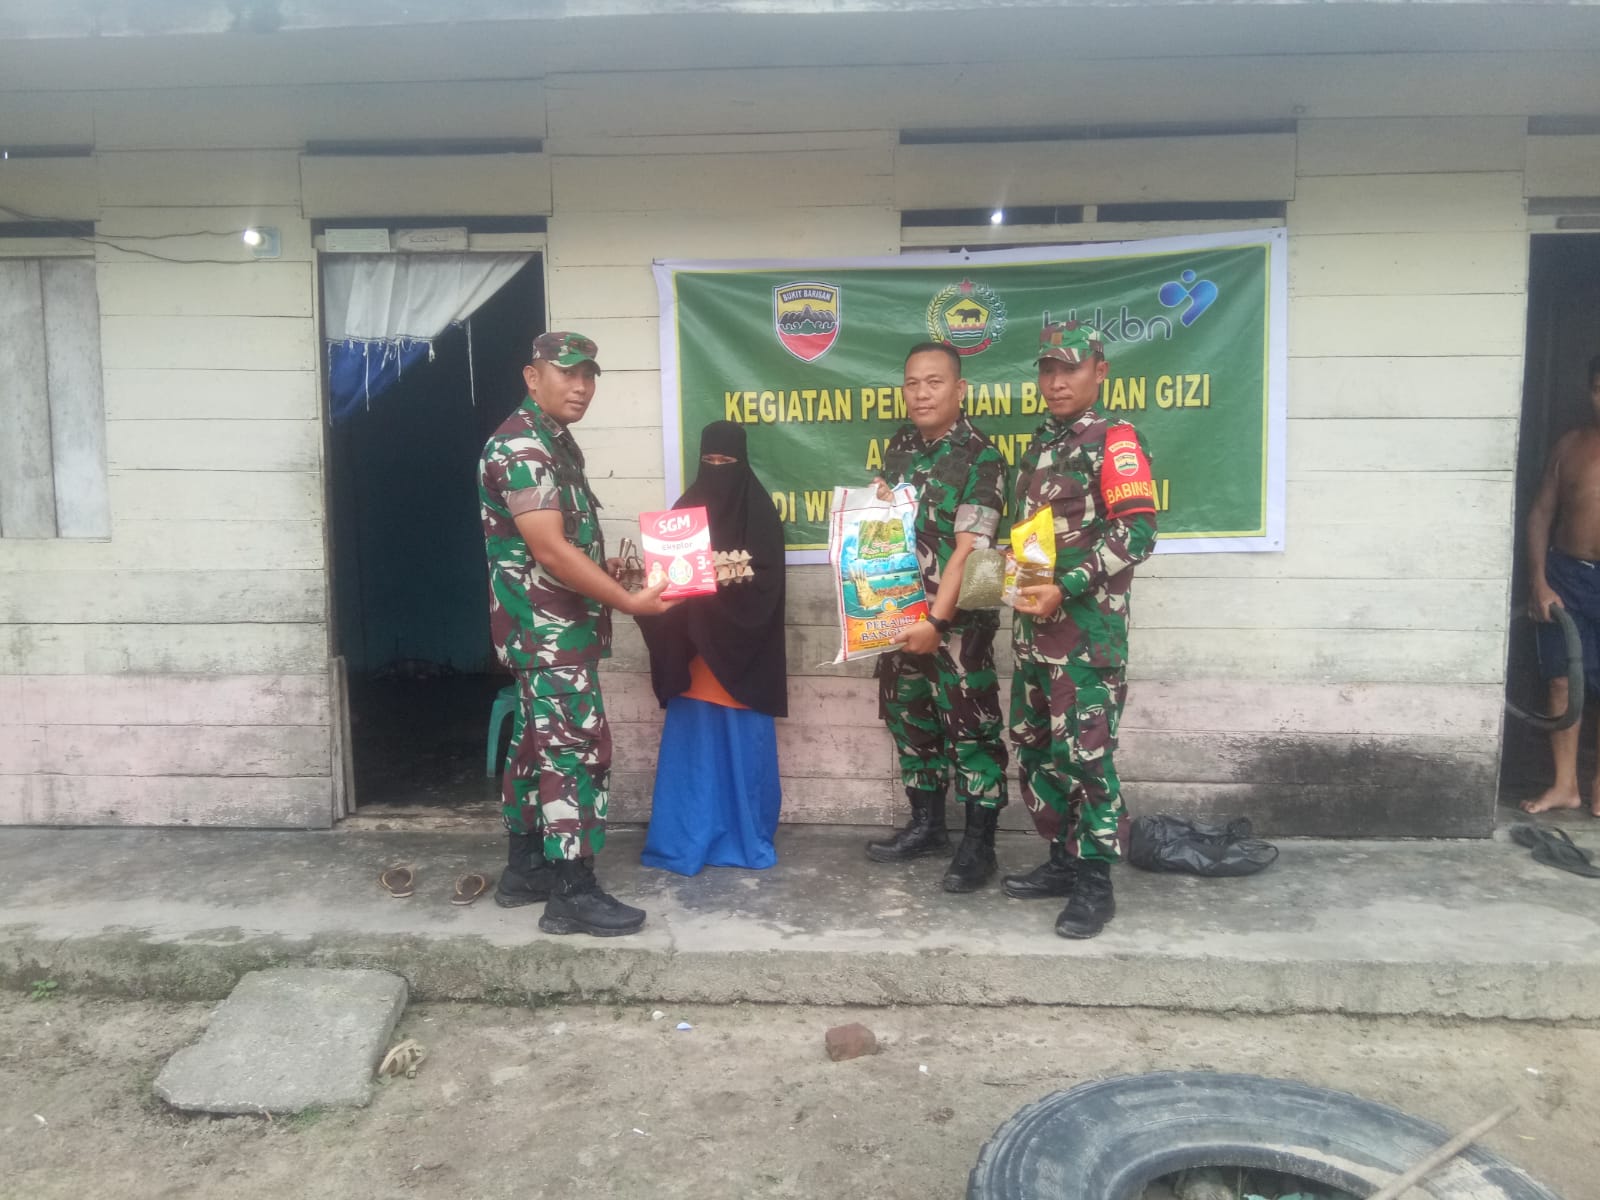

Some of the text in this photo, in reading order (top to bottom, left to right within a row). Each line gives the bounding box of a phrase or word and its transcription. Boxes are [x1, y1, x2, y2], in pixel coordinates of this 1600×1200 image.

[782, 289, 832, 302] BUKIT BARISAN
[725, 373, 1210, 423] KEGIATAN PEMIAN BAAN GIZI
[658, 514, 690, 534] SGM
